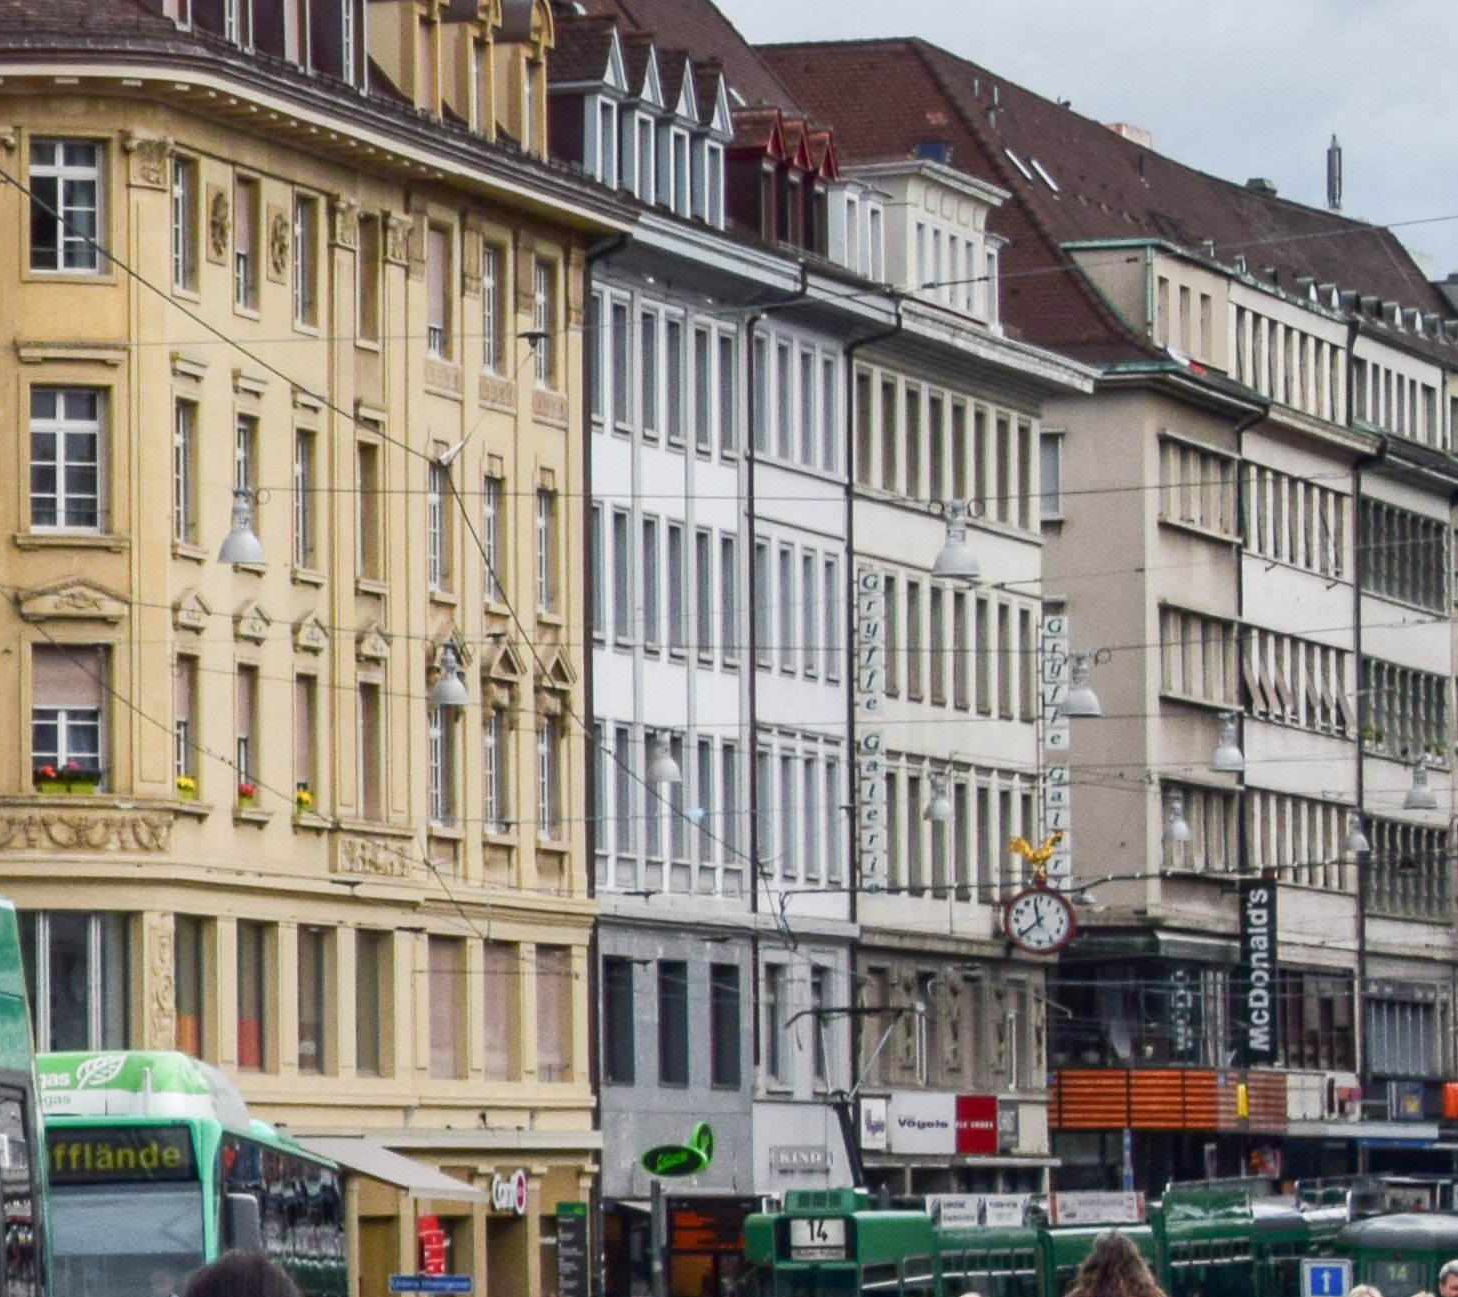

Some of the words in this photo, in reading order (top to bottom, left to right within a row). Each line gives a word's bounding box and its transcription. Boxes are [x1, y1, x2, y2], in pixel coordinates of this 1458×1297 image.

[861, 572, 881, 711] Gryffe
[1246, 888, 1270, 1052] McDonald's
[897, 1116, 949, 1130] Vögele
[779, 1151, 822, 1165] KIND
[807, 1219, 828, 1242] 14
